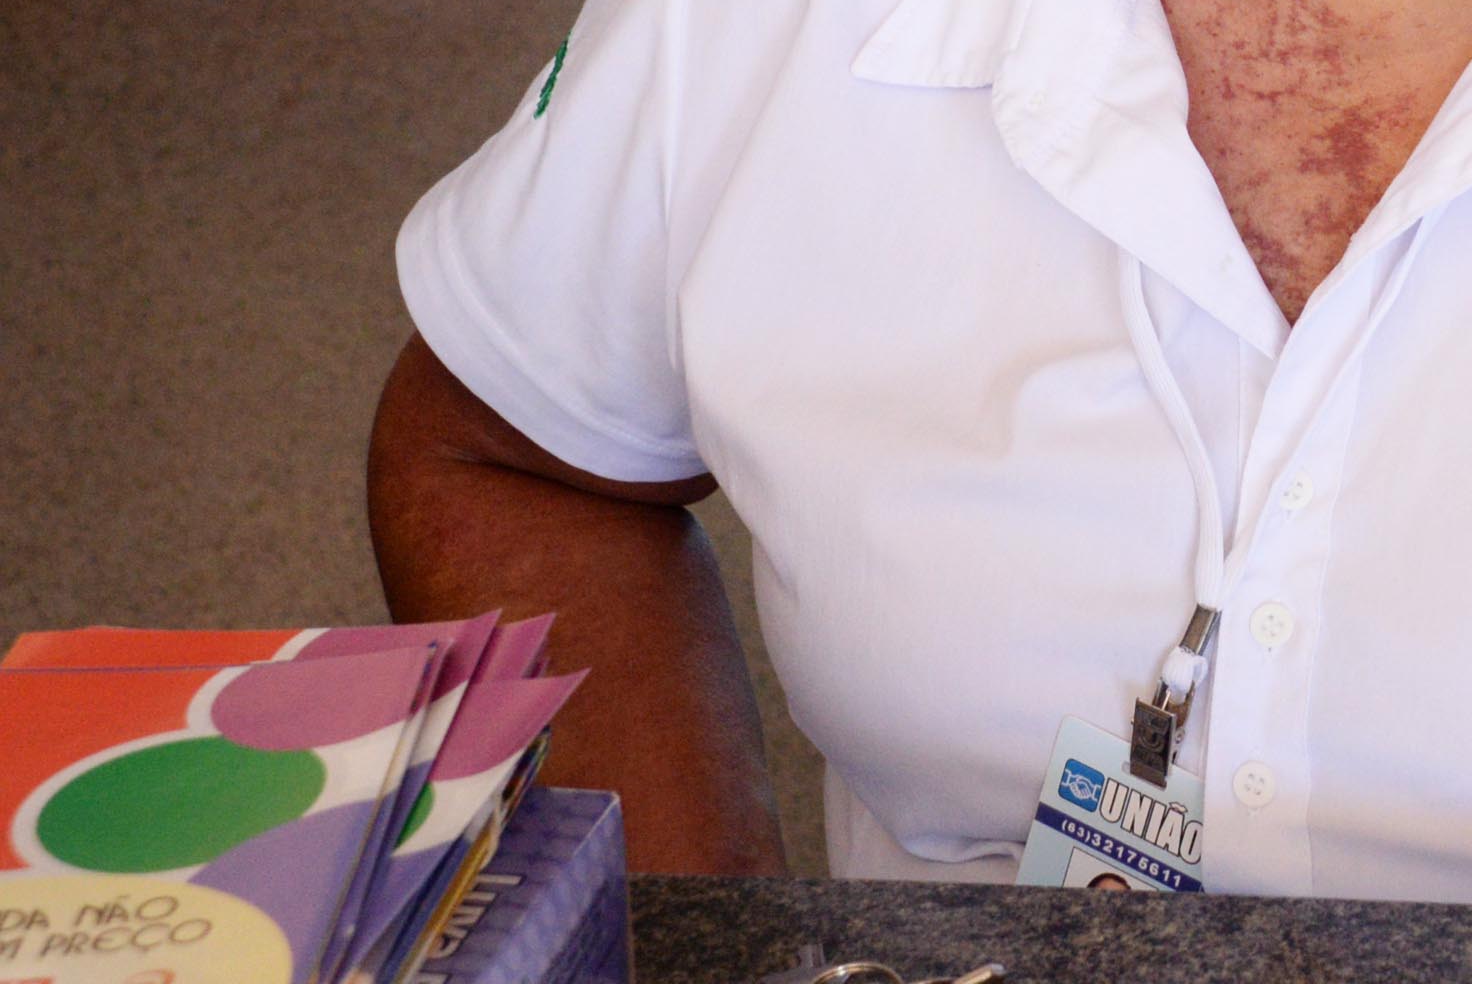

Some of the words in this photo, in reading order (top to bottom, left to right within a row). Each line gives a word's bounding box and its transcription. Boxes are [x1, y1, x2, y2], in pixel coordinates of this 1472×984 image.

[1099, 777, 1203, 864] UNIÃO
[75, 894, 178, 927] NÃO
[40, 919, 212, 958] PREÇO
